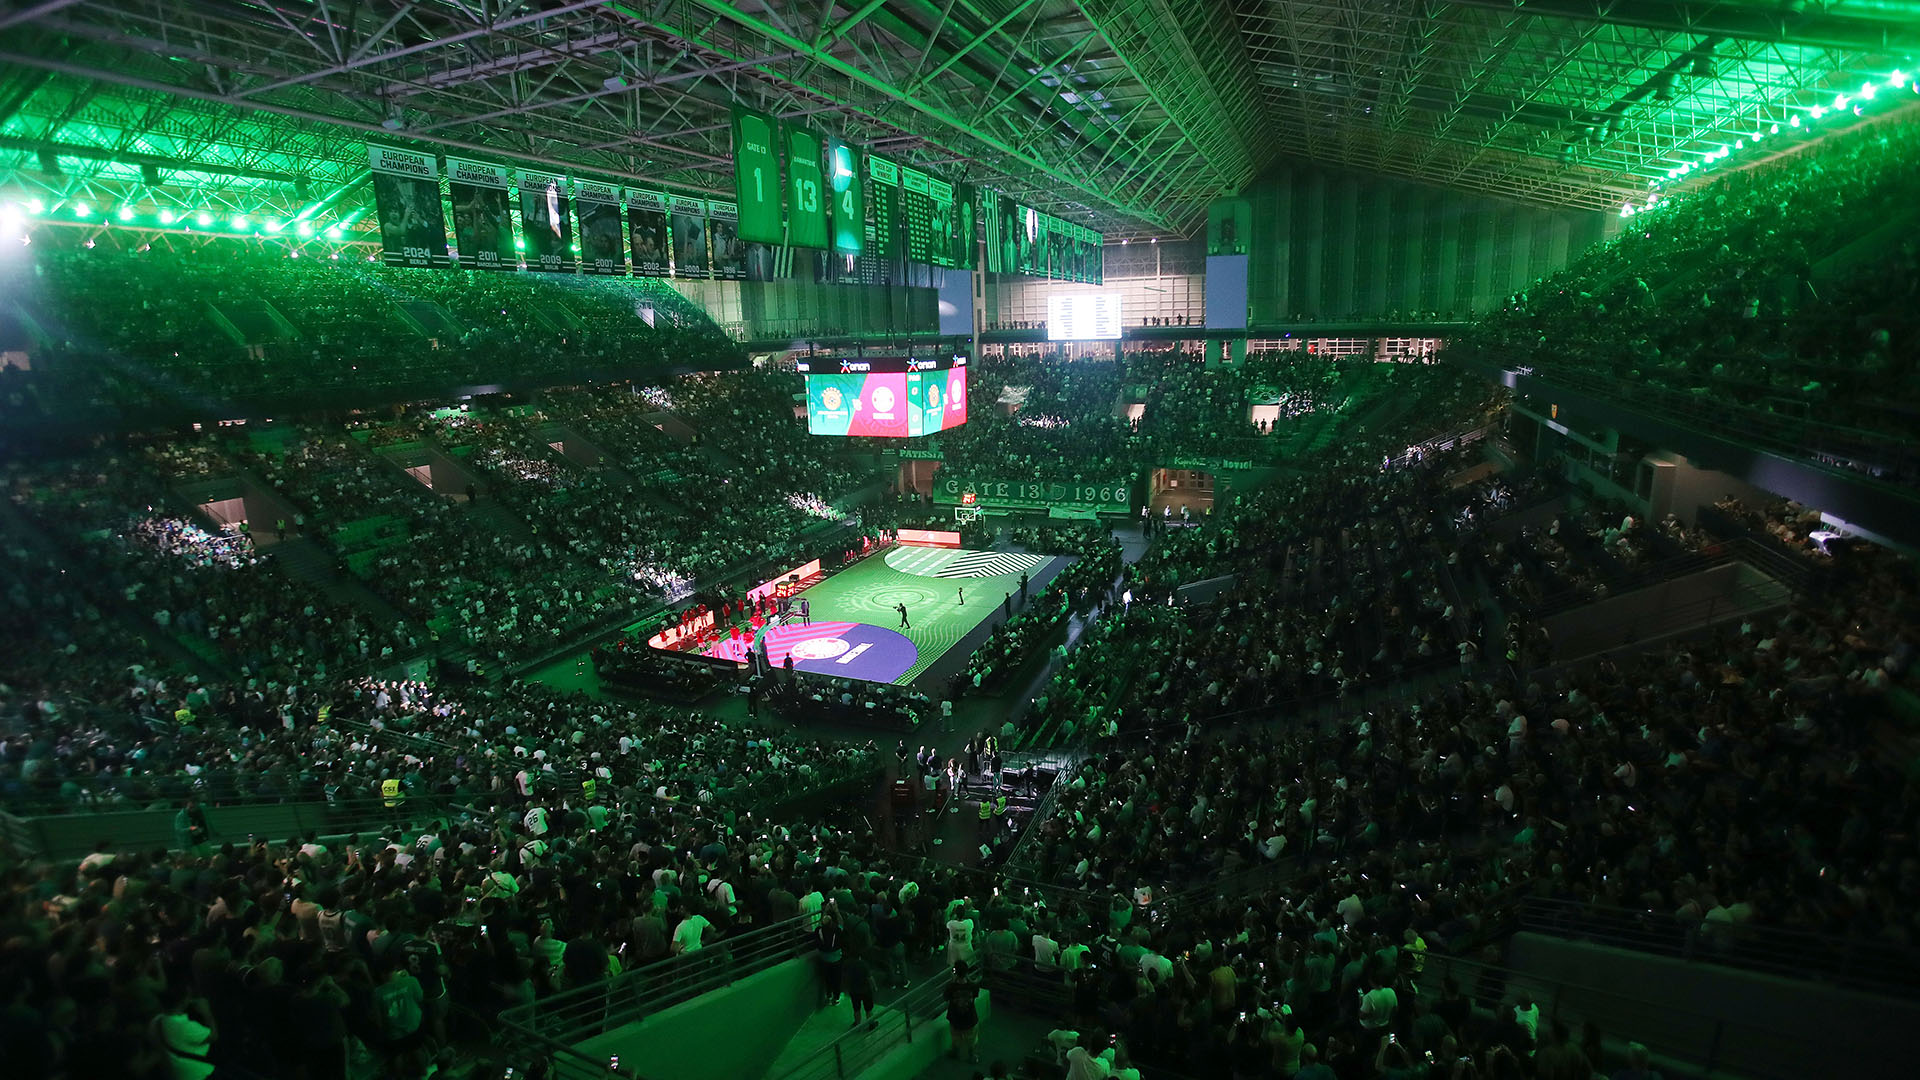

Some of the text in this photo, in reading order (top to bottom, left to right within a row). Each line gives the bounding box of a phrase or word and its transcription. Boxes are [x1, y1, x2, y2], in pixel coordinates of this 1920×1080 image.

[746, 142, 767, 155] GATE 13
[382, 150, 425, 166] EUROPEAN
[380, 159, 430, 175] CHAMPIONS
[458, 162, 496, 176] EUROPEAN
[456, 170, 500, 185] CHAMPIONS
[525, 173, 559, 186] EUROPEAN
[524, 180, 562, 193] CHAMPIONS
[583, 183, 612, 194] EUROPEAN
[754, 167, 763, 203] 1
[581, 190, 615, 201] CHAMPIONS
[632, 192, 658, 201] EUROPEAN
[795, 178, 817, 213] 13
[631, 198, 660, 208] CHAMPIONS
[675, 199, 699, 208] EUROPEAN
[714, 204, 736, 212] EUROPEAN
[842, 190, 854, 220] 4
[674, 205, 701, 215] CHAMPIONS
[403, 246, 431, 259] 2024
[478, 251, 498, 261] 2011
[540, 254, 562, 265] 2009
[595, 258, 613, 268] 2007
[643, 262, 660, 271] 2002
[684, 264, 700, 273] 2000
[946, 480, 1127, 502] GATE 13 1966
[527, 815, 538, 826] 26
